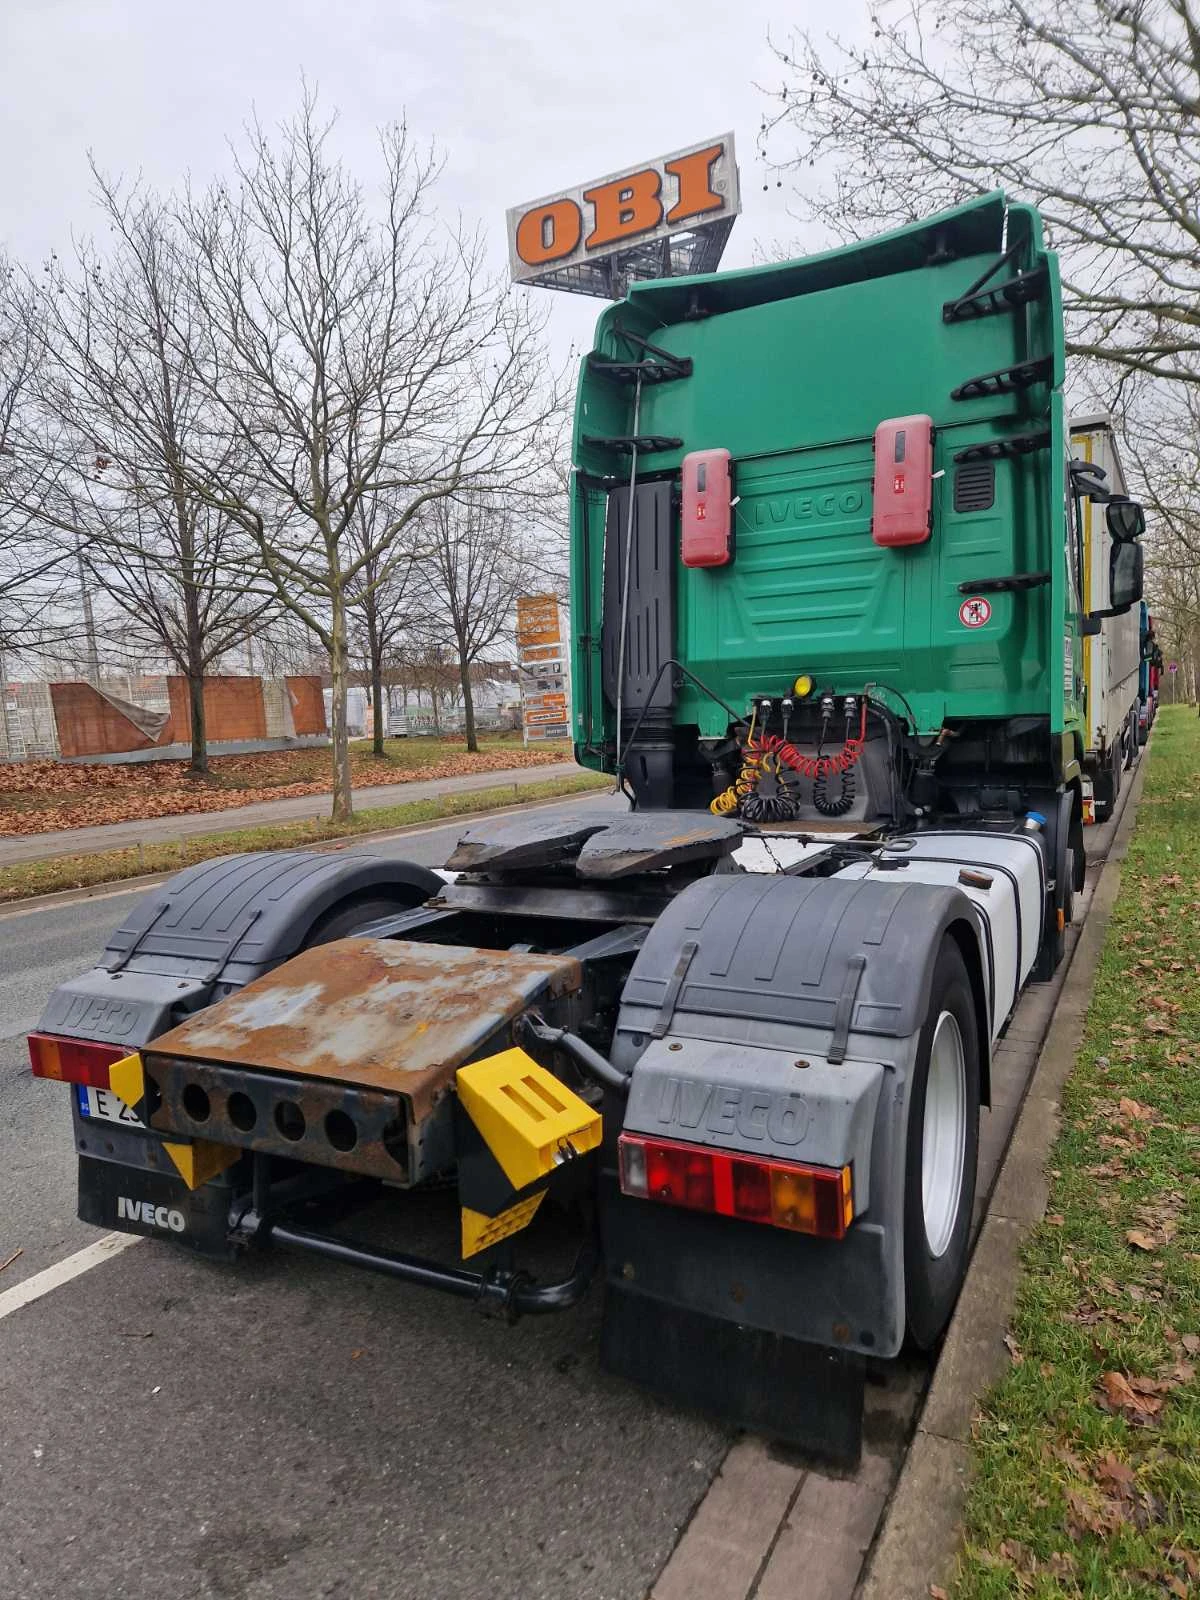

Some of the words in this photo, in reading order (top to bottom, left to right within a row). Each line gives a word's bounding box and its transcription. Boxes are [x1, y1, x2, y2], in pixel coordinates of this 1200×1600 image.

[515, 142, 726, 266] OBI
[754, 490, 864, 526] IVECO
[56, 994, 141, 1037] IVECO
[656, 1077, 810, 1146] IVECO
[117, 1196, 186, 1233] IVECO
